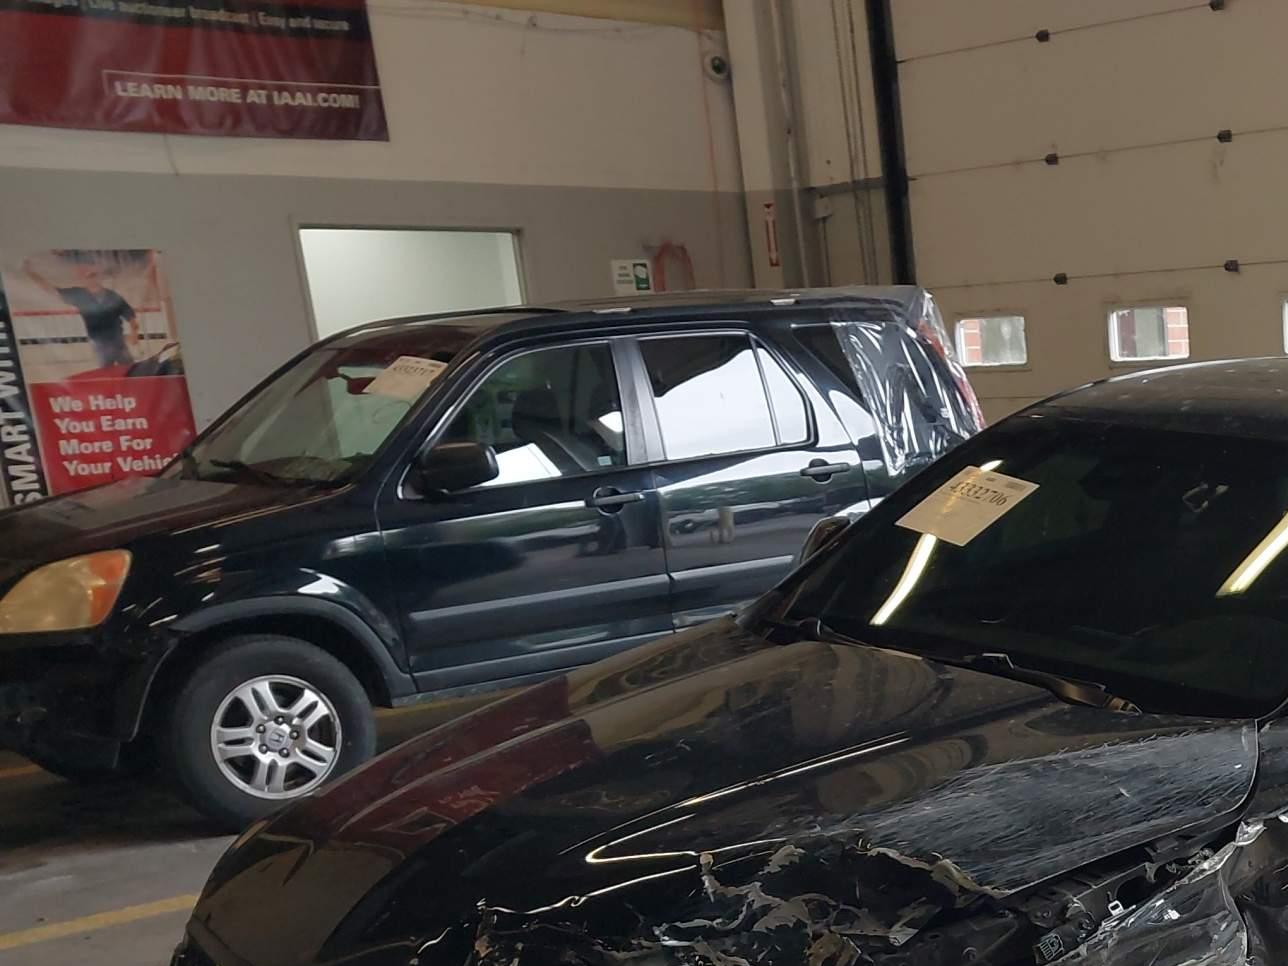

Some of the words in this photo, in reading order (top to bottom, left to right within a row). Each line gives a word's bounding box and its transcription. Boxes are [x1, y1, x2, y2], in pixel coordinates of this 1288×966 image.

[114, 81, 183, 99] LEARN
[186, 85, 242, 103] MORE
[246, 89, 268, 104] AT
[49, 394, 83, 413] We
[88, 393, 137, 413] Help
[53, 417, 96, 434] You
[100, 415, 148, 432] Earn
[58, 438, 113, 456] More
[119, 435, 153, 452] For
[62, 460, 113, 476] Your
